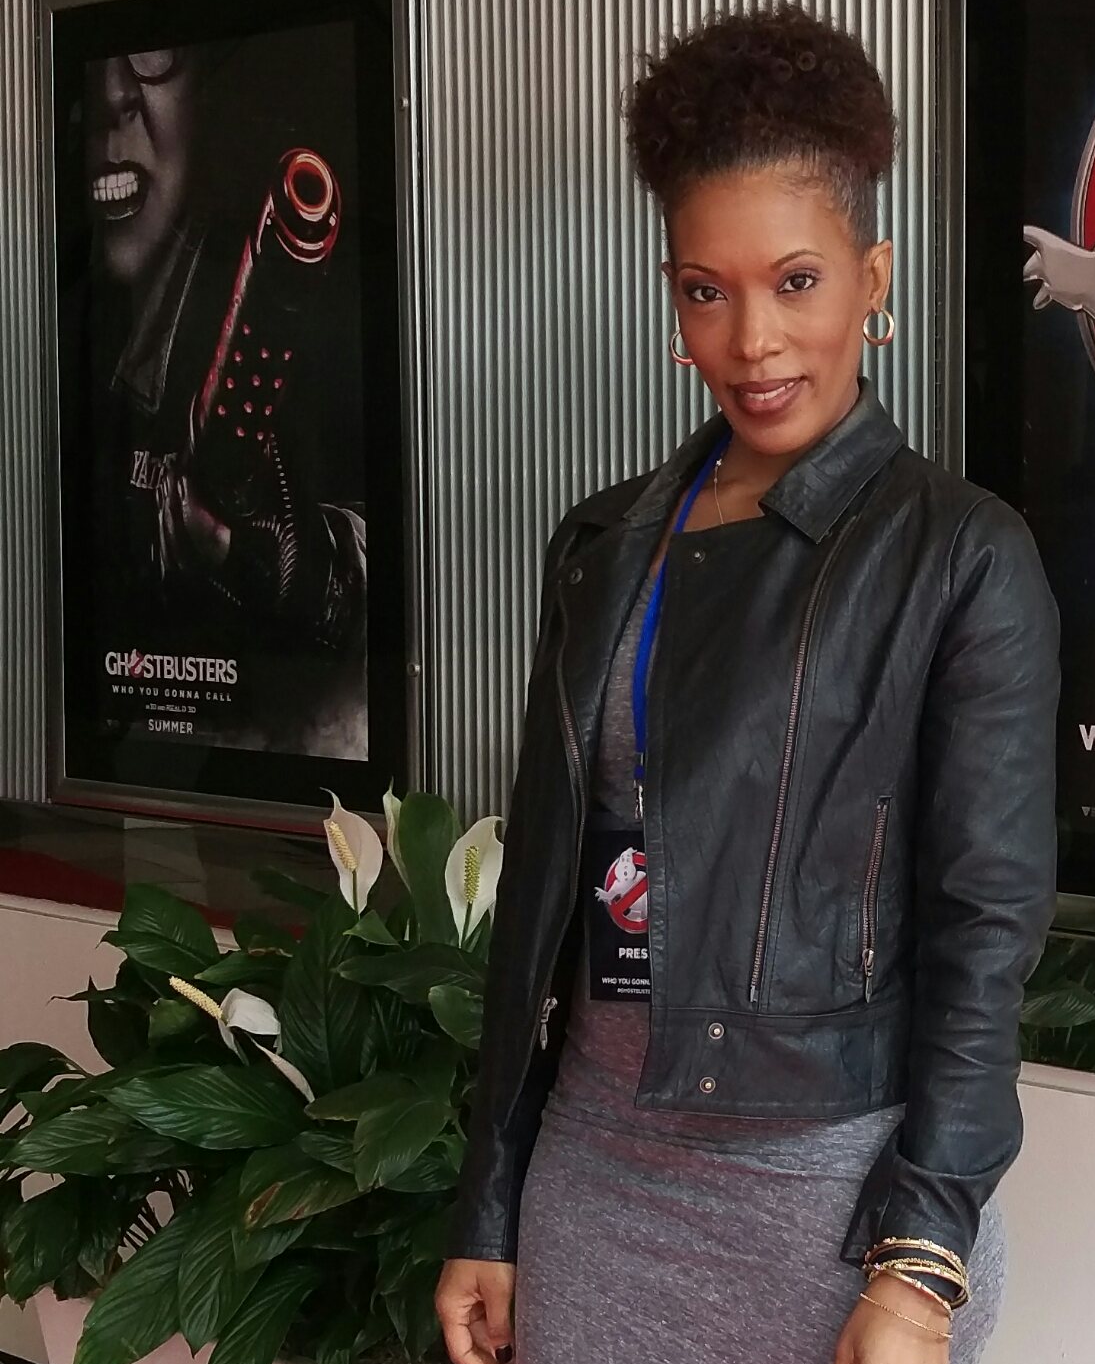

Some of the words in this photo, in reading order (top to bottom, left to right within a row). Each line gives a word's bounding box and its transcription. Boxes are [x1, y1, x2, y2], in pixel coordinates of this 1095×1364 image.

[104, 648, 238, 685] GHOSTBUSTERS
[111, 684, 134, 695] WHO
[139, 686, 159, 697] YOU
[164, 688, 200, 700] GONNA
[205, 691, 232, 702] CALL
[148, 718, 193, 735] SUMMER
[618, 947, 649, 960] PRES
